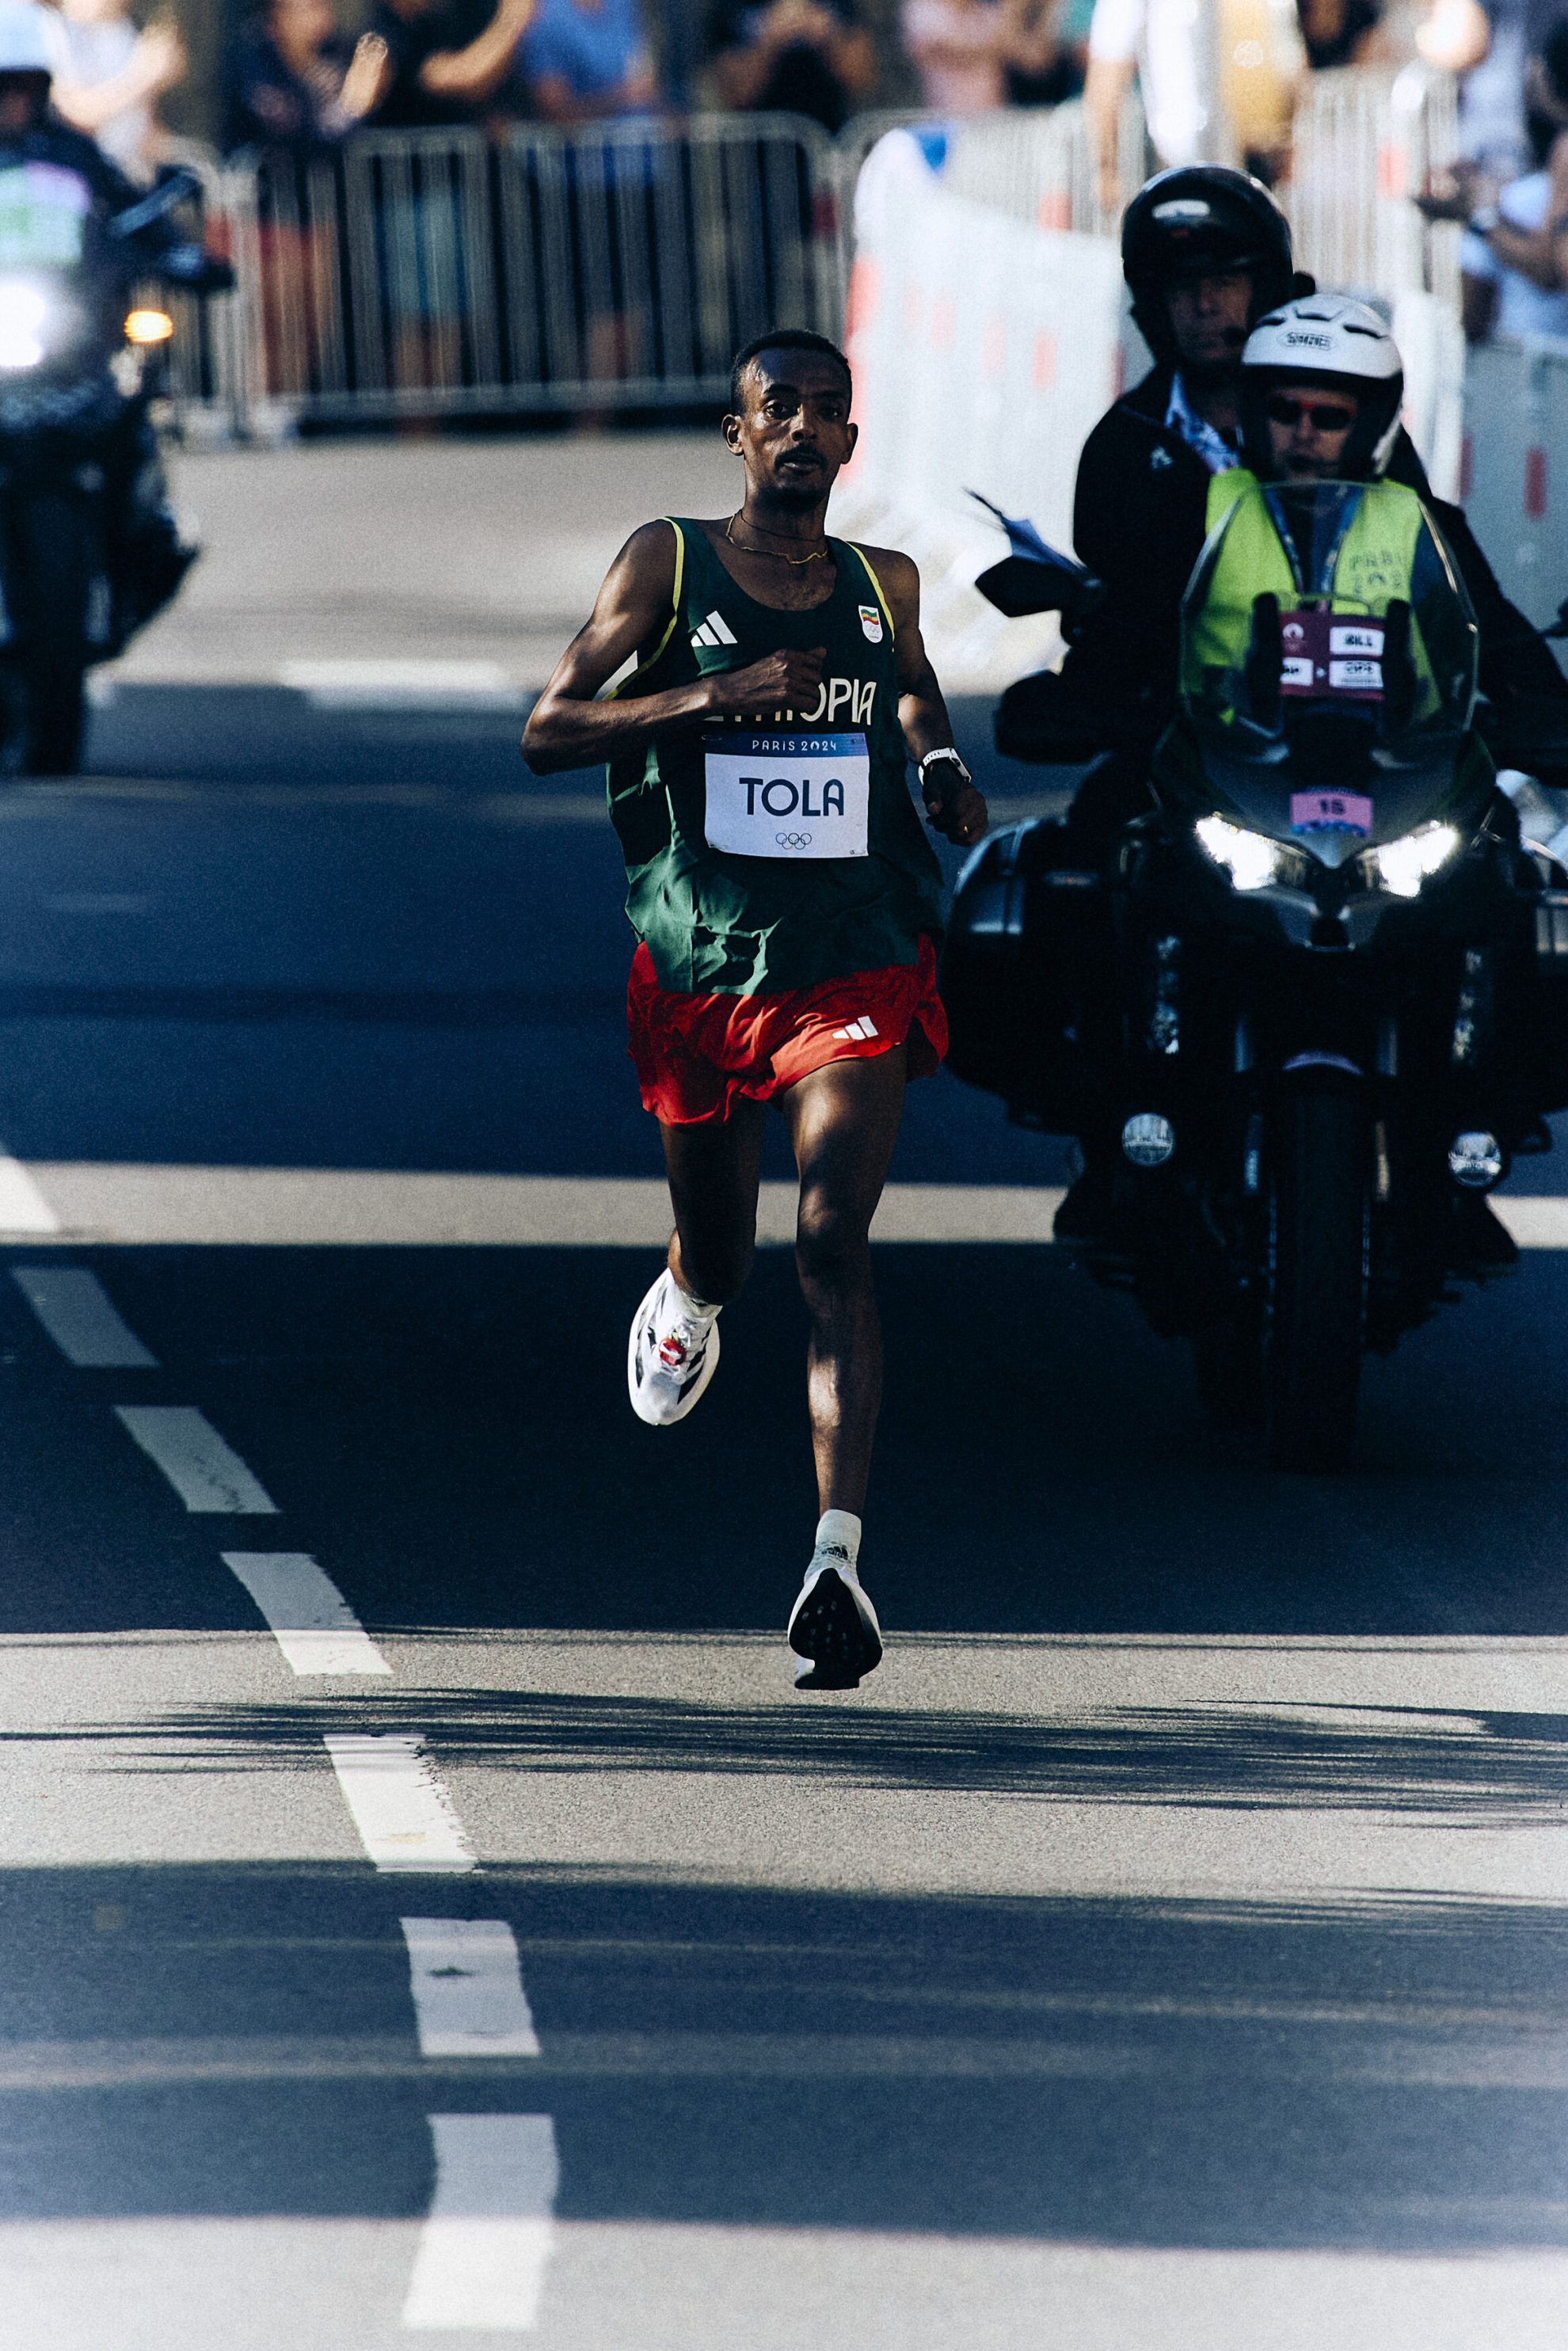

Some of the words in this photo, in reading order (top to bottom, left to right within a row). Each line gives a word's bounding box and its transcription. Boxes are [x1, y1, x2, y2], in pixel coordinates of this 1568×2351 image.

[752, 740, 795, 751] PARIS
[801, 741, 836, 751] 2024
[739, 778, 844, 816] TOLA
